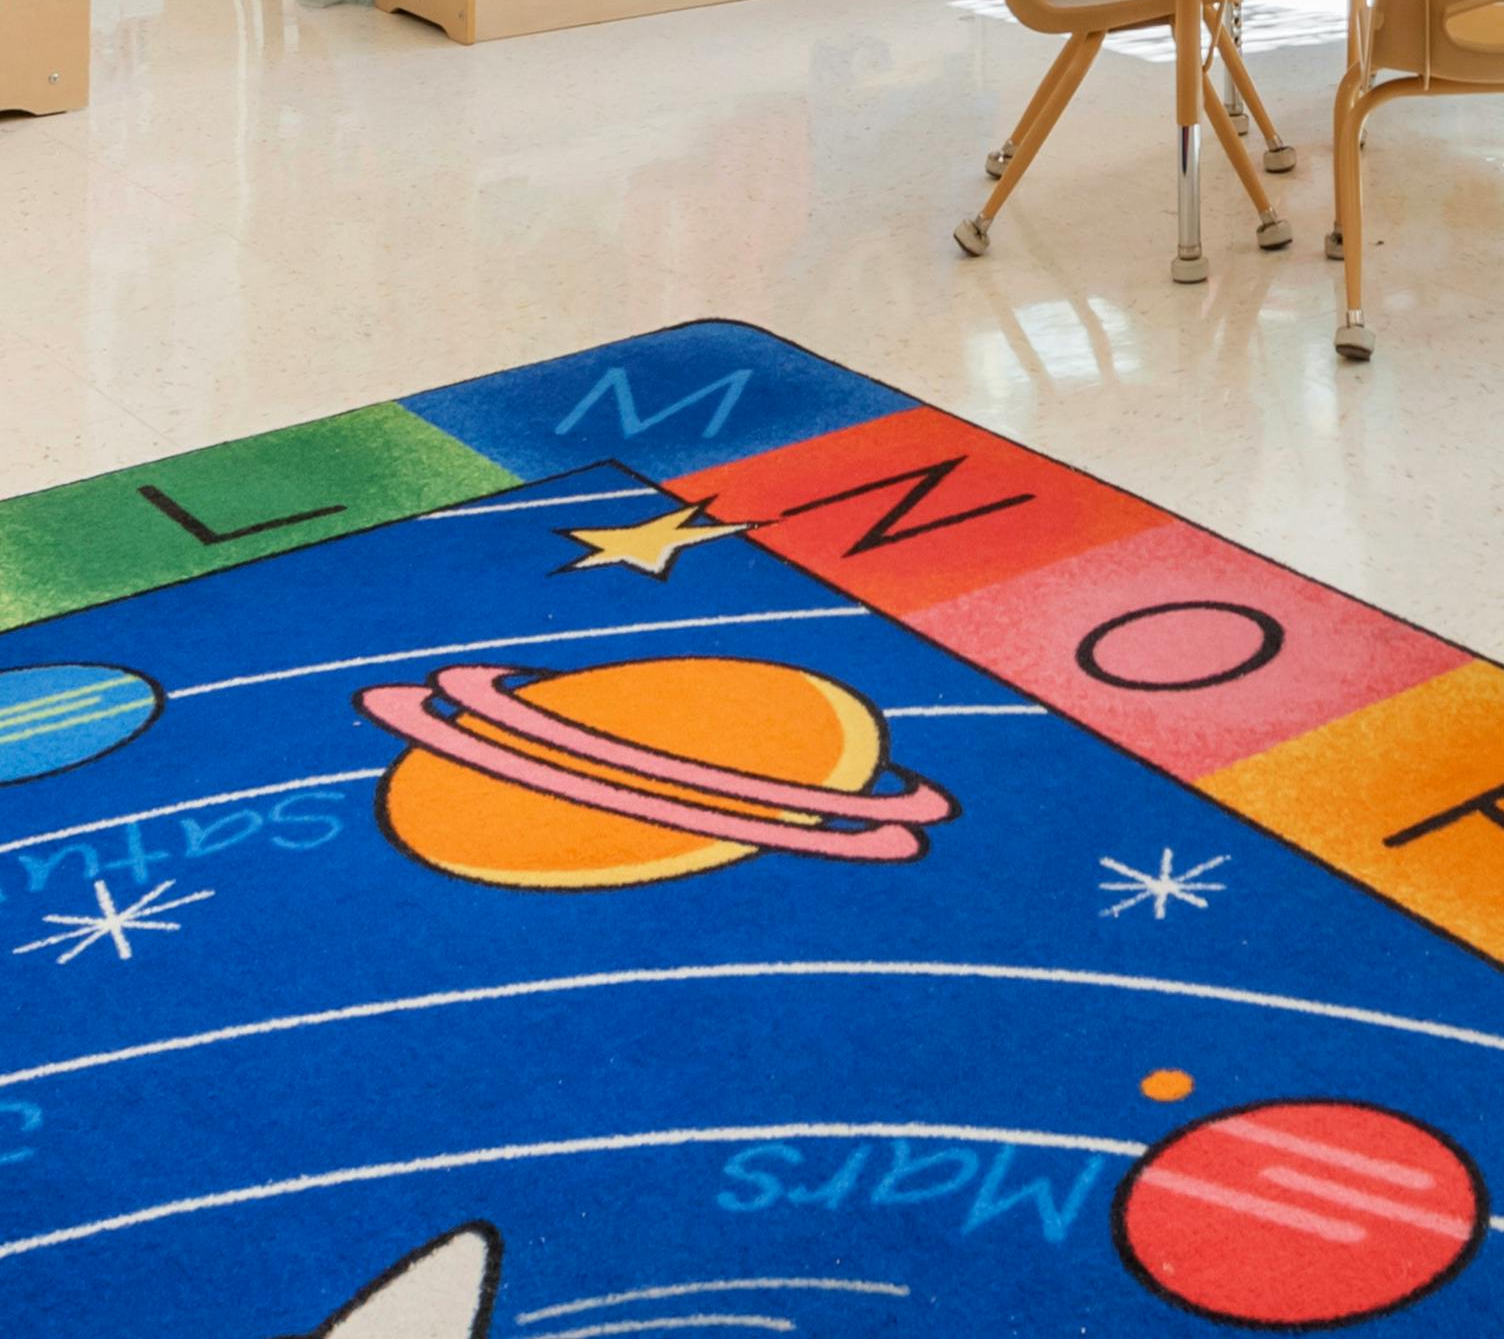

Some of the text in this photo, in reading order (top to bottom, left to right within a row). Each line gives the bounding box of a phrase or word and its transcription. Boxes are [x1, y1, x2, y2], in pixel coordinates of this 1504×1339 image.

[555, 364, 756, 441] M
[137, 480, 350, 548] L
[786, 461, 1037, 558] N
[1073, 599, 1287, 694] O
[715, 1139, 1107, 1246] Mars
